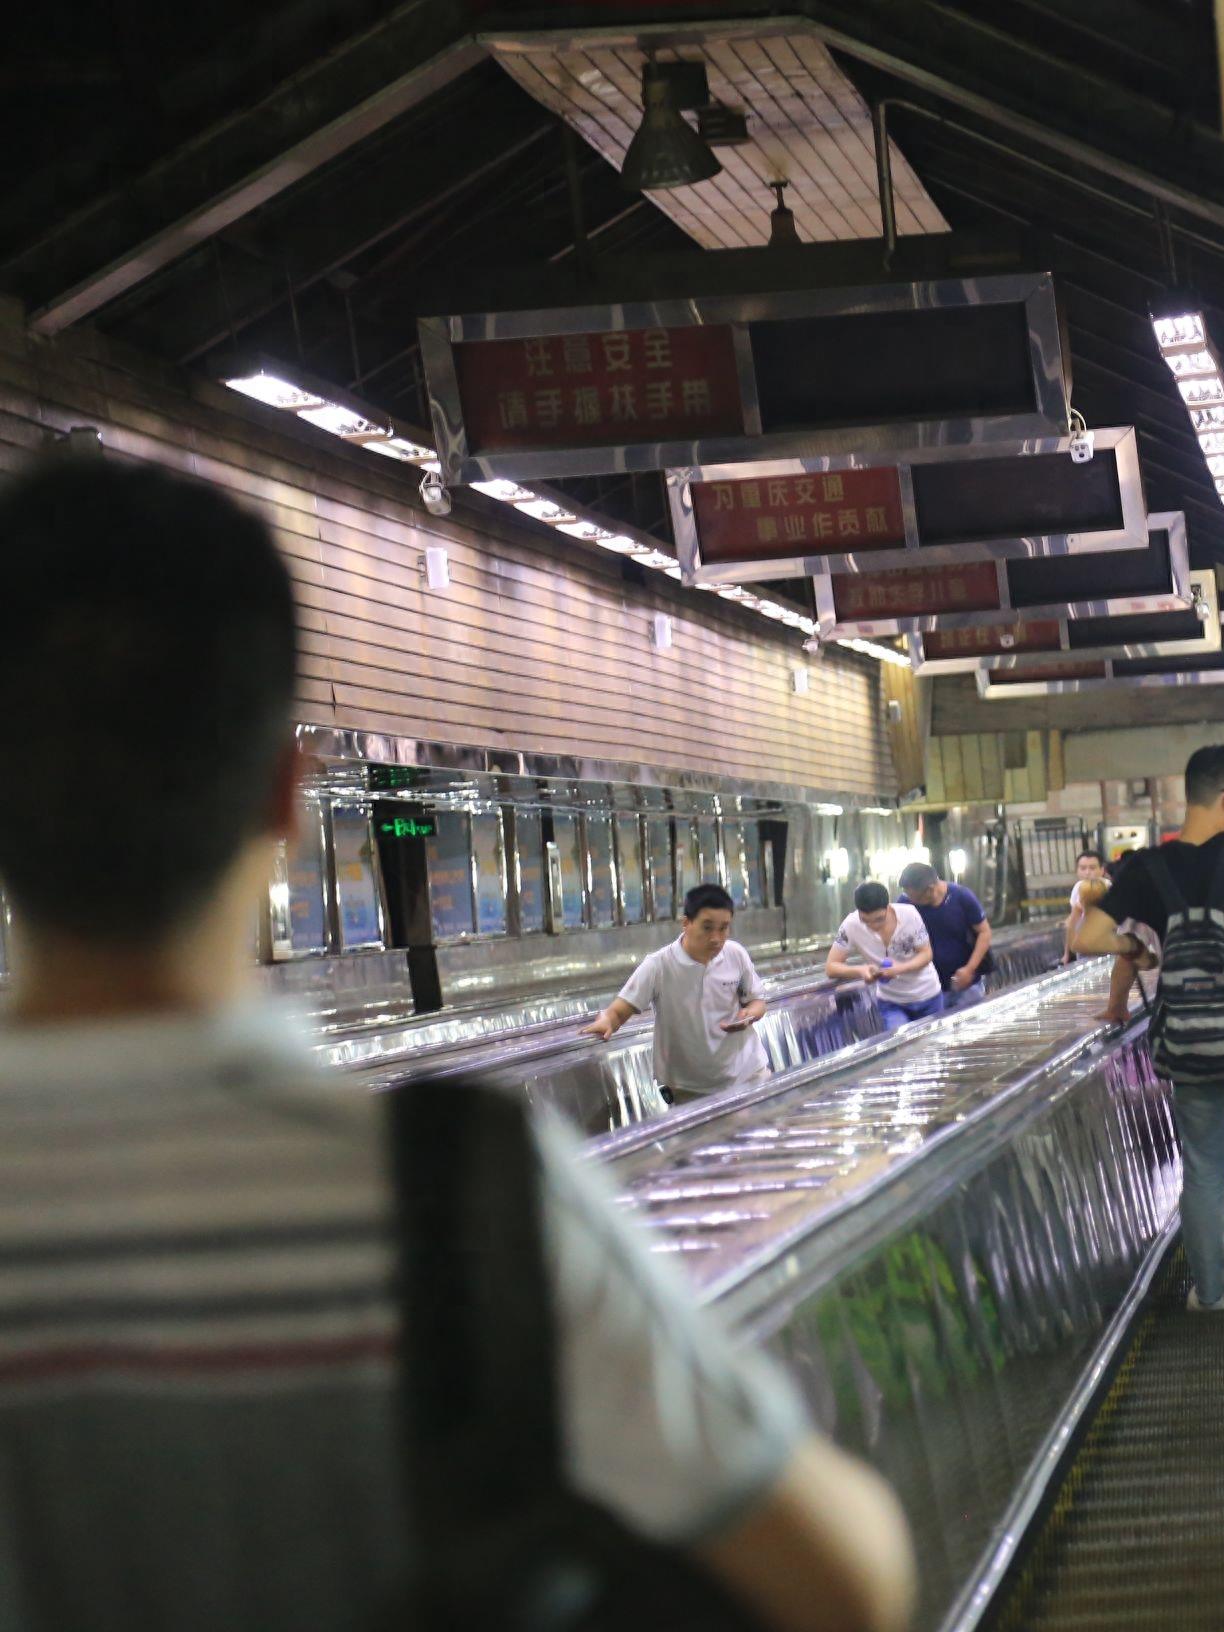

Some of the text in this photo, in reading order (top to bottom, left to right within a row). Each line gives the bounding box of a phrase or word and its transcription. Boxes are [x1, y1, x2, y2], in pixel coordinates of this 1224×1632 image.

[525, 329, 673, 377] 注意安全
[712, 474, 845, 510] 为重庆交通
